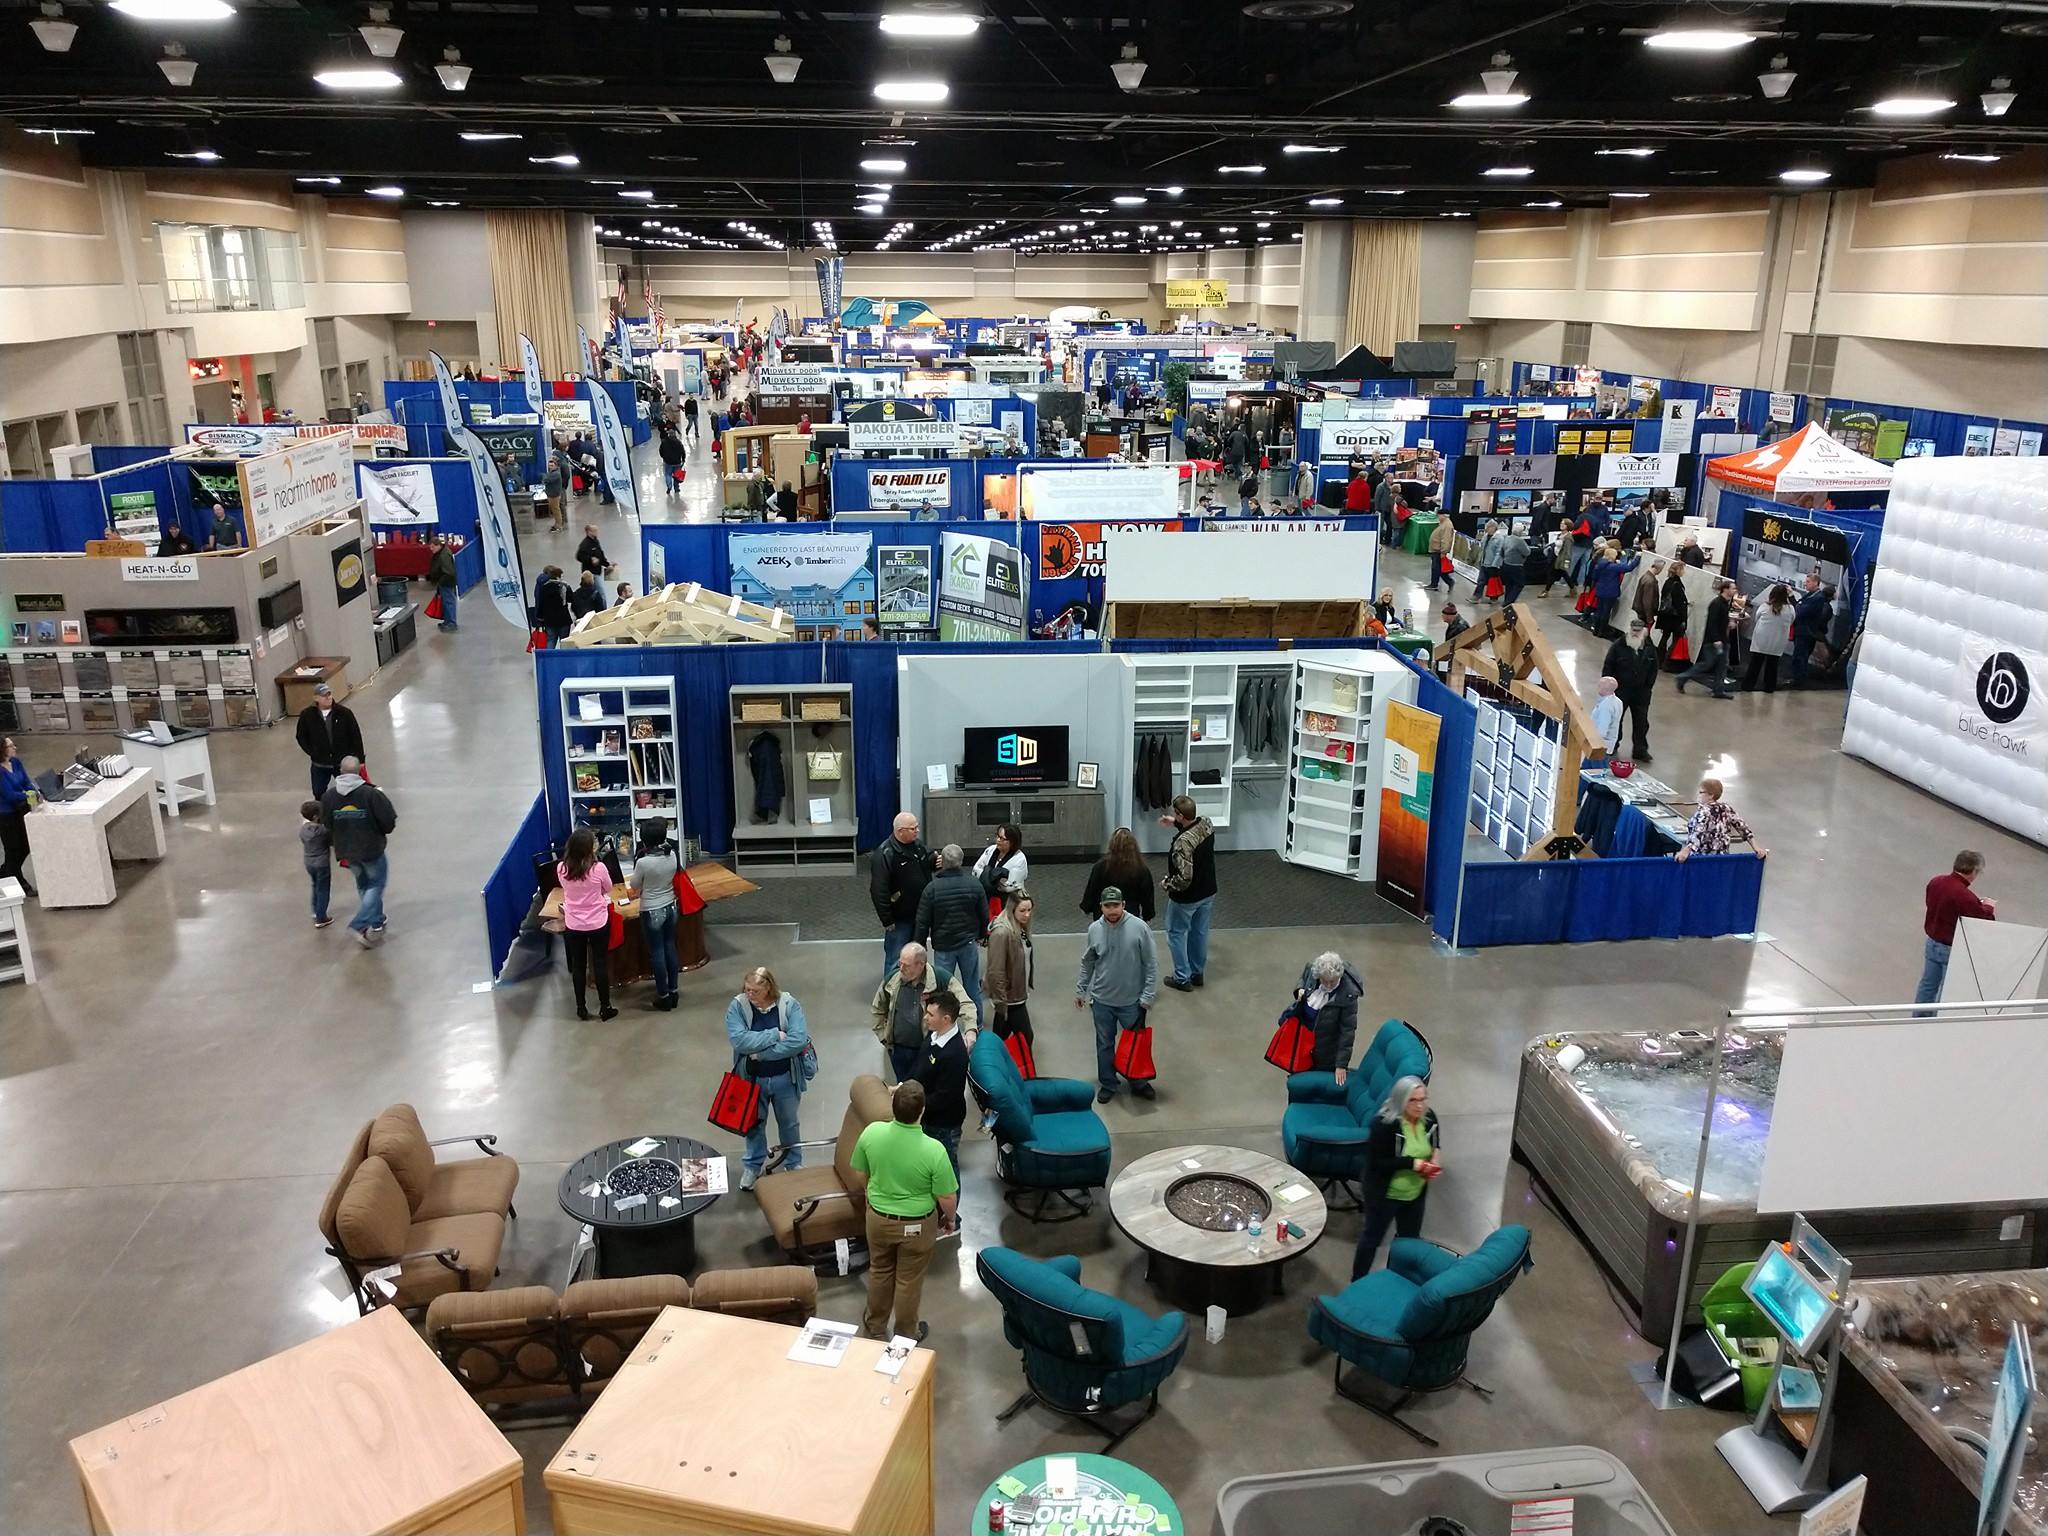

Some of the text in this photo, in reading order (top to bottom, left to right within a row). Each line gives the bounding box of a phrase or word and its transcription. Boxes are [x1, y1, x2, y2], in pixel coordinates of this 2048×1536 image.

[761, 367, 796, 375] MIDWEST
[761, 376, 800, 385] MIDWEST
[545, 402, 576, 412] Superior
[545, 411, 580, 421] Window
[854, 423, 955, 434] DAKOTA TIMBER
[483, 437, 534, 450] GACY
[1335, 435, 1390, 445] ODDEN
[1618, 463, 1660, 471] WELCH
[890, 474, 924, 486] FOAM
[925, 472, 947, 485] LLC
[1489, 476, 1542, 485] Elite Homes
[1782, 529, 1826, 552] CAMBRIA
[757, 557, 847, 565] AZEK TimberTech
[128, 565, 191, 574] HEAT-N-GLO
[940, 600, 957, 610] CUSTOM
[957, 603, 971, 613] DECKS
[1958, 712, 2028, 756] blue hawk
